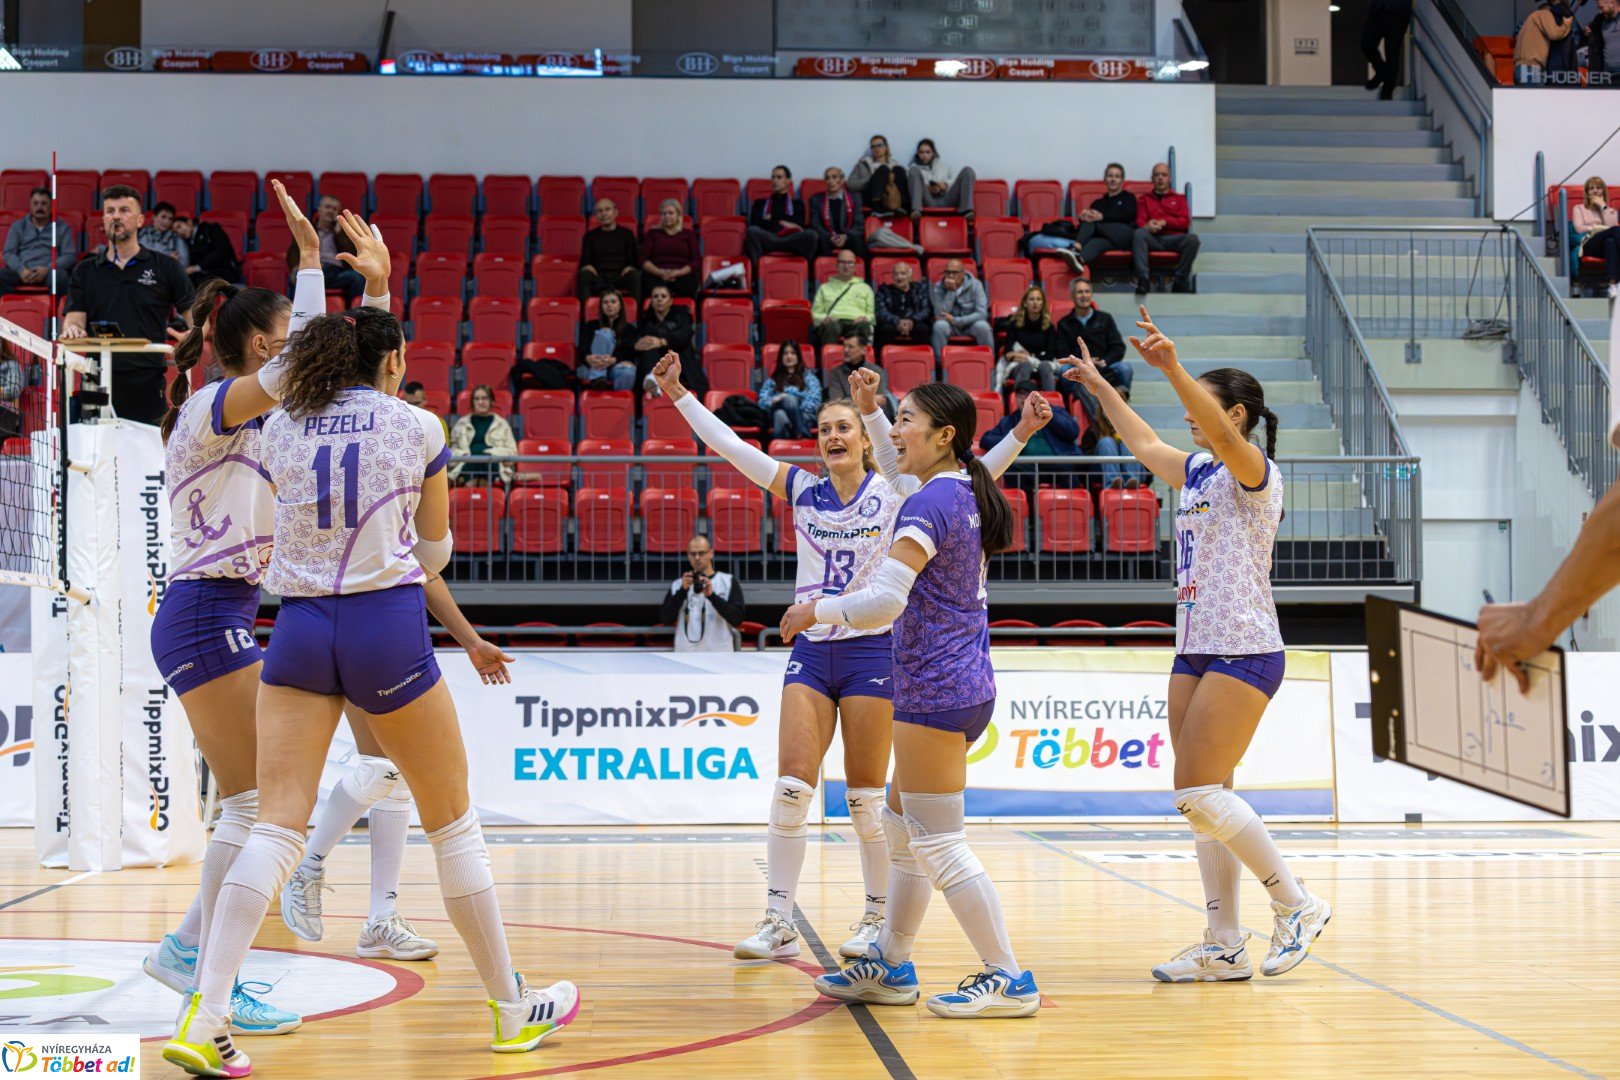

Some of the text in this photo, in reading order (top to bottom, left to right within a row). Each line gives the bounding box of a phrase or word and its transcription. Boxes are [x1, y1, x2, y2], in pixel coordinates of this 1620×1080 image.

[114, 52, 140, 66] BH
[258, 53, 285, 67] BH
[685, 56, 710, 71] BH
[822, 57, 849, 73] BH
[1098, 60, 1123, 76] BH
[304, 411, 375, 437] PEZELJ
[311, 442, 361, 530] 11
[822, 549, 856, 588] 13
[515, 695, 760, 737] TippmixPRO
[1010, 695, 1168, 720] NYÍREGYHÁZ
[143, 684, 170, 832] TippmixPRO
[1009, 727, 1165, 769] Többet
[514, 747, 760, 781] EXTRALIGA
